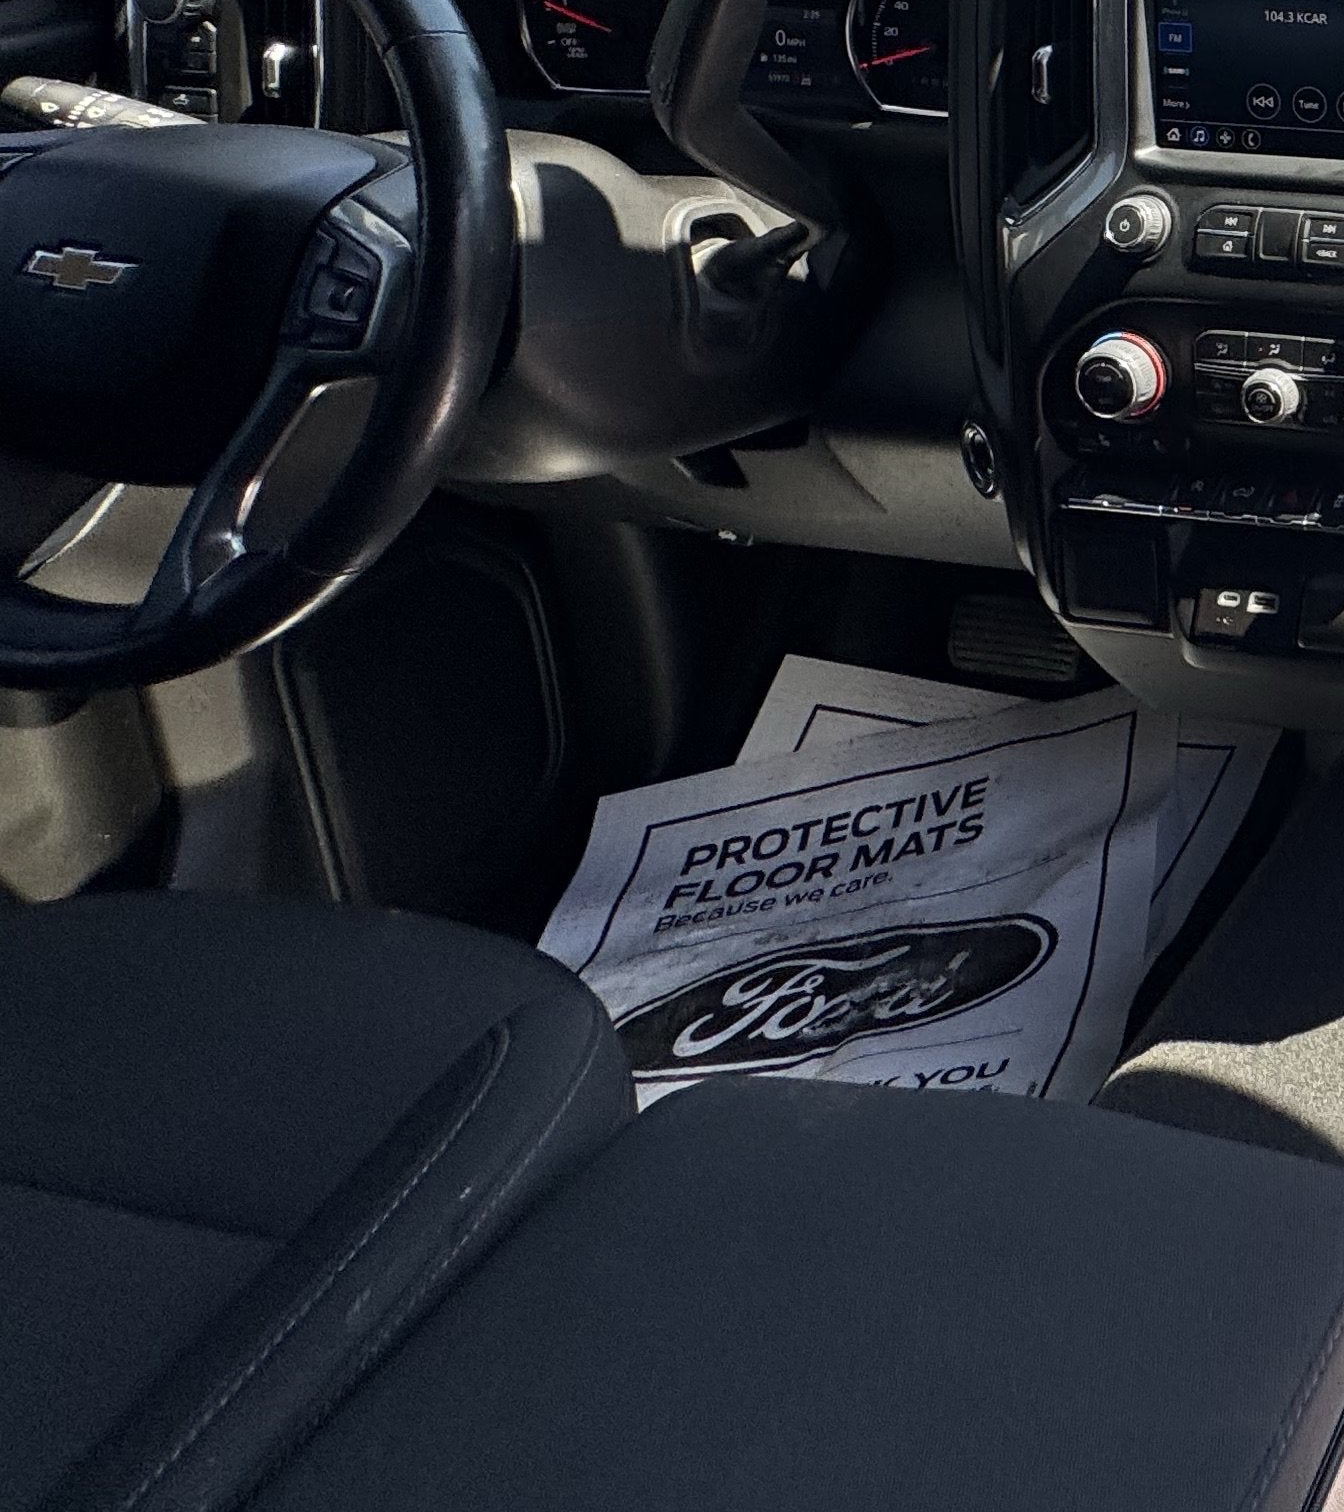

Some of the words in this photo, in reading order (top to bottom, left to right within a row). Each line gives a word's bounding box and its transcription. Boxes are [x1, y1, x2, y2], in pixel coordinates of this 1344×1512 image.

[883, 26, 899, 37] 20
[1264, 9, 1295, 24] 104.3
[1296, 11, 1328, 25] KCAR
[1298, 99, 1320, 110] Tune
[680, 776, 990, 876] PROTECTIVE
[663, 852, 840, 910] FLOOR
[849, 812, 985, 872] MATS
[653, 896, 776, 934] Because
[785, 888, 822, 908] we
[829, 869, 893, 899] care.
[913, 1058, 1010, 1091] YOU
